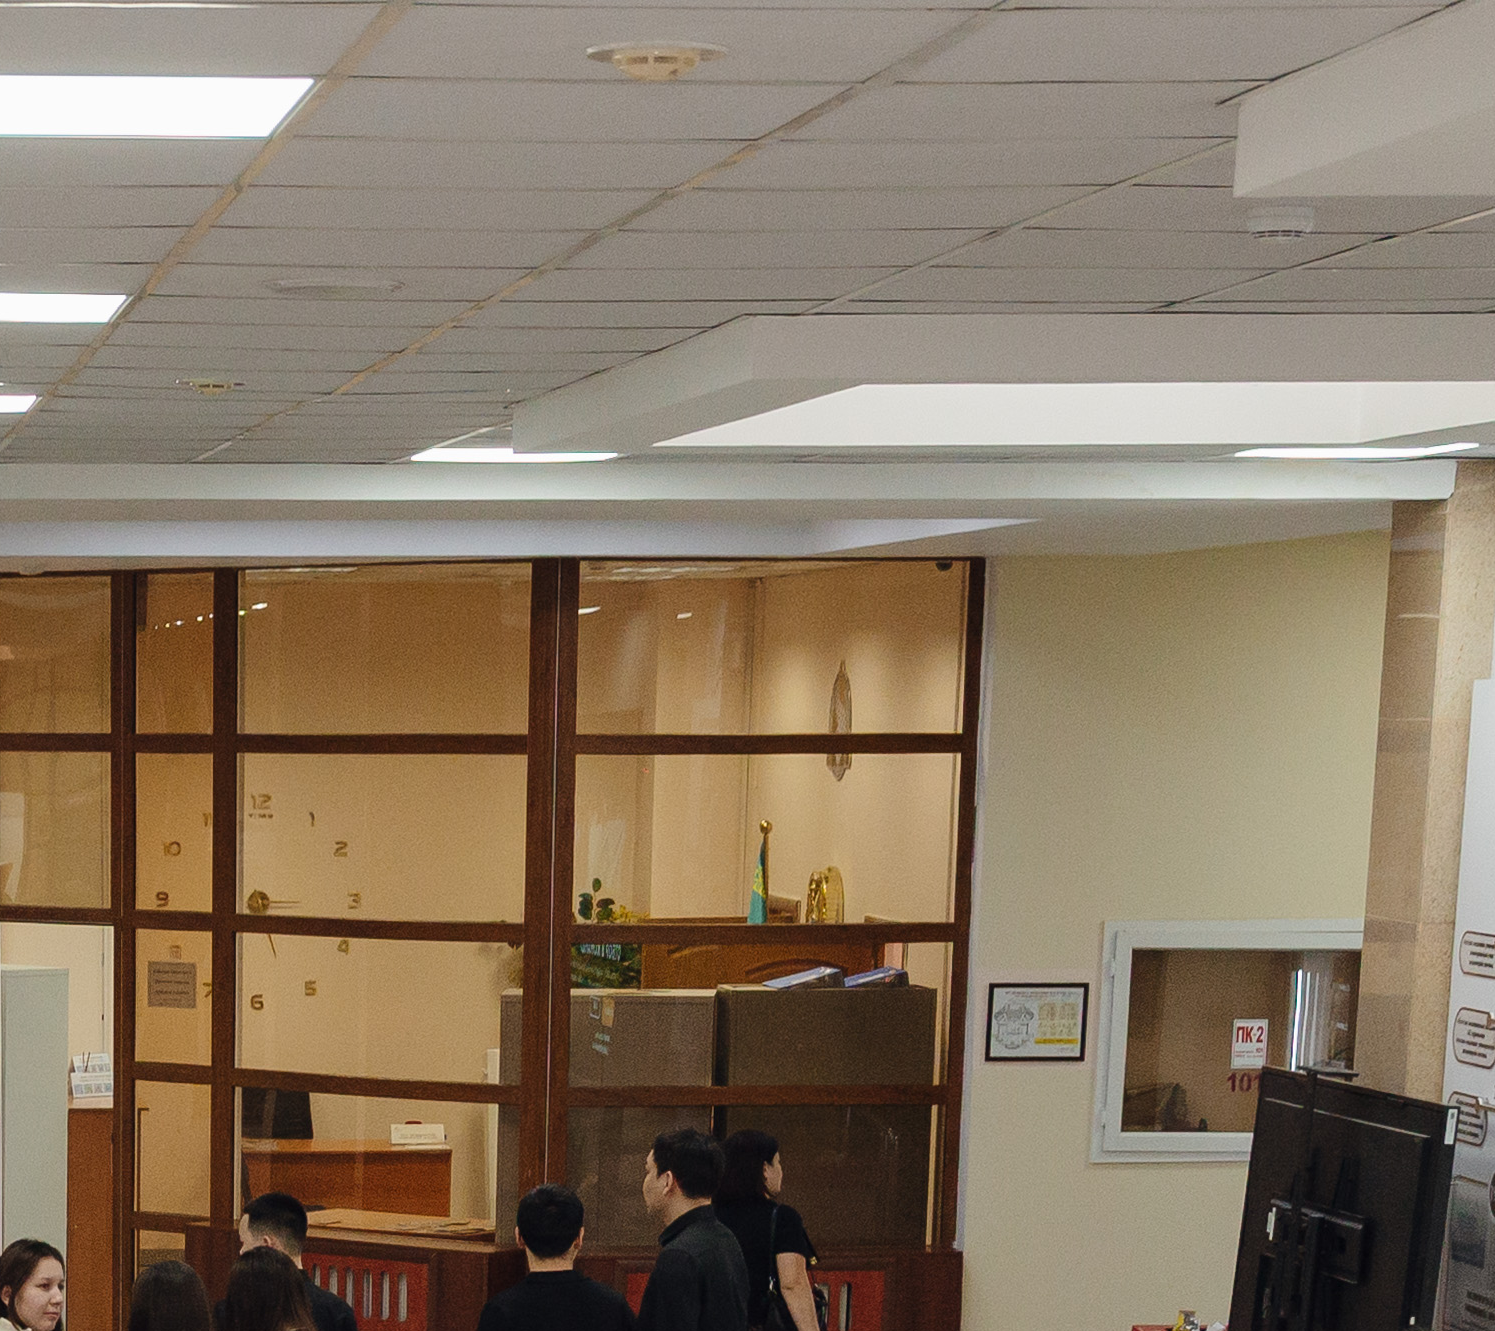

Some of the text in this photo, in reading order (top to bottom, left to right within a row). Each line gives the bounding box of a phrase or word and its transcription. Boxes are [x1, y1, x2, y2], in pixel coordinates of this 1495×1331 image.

[251, 793, 273, 810] 12
[163, 840, 182, 857] 10
[333, 840, 348, 857] 2
[156, 890, 169, 907] 9
[337, 939, 350, 956] 4
[304, 980, 317, 997] 5
[250, 994, 264, 1011] 6
[1236, 1025, 1264, 1043] ПК-2
